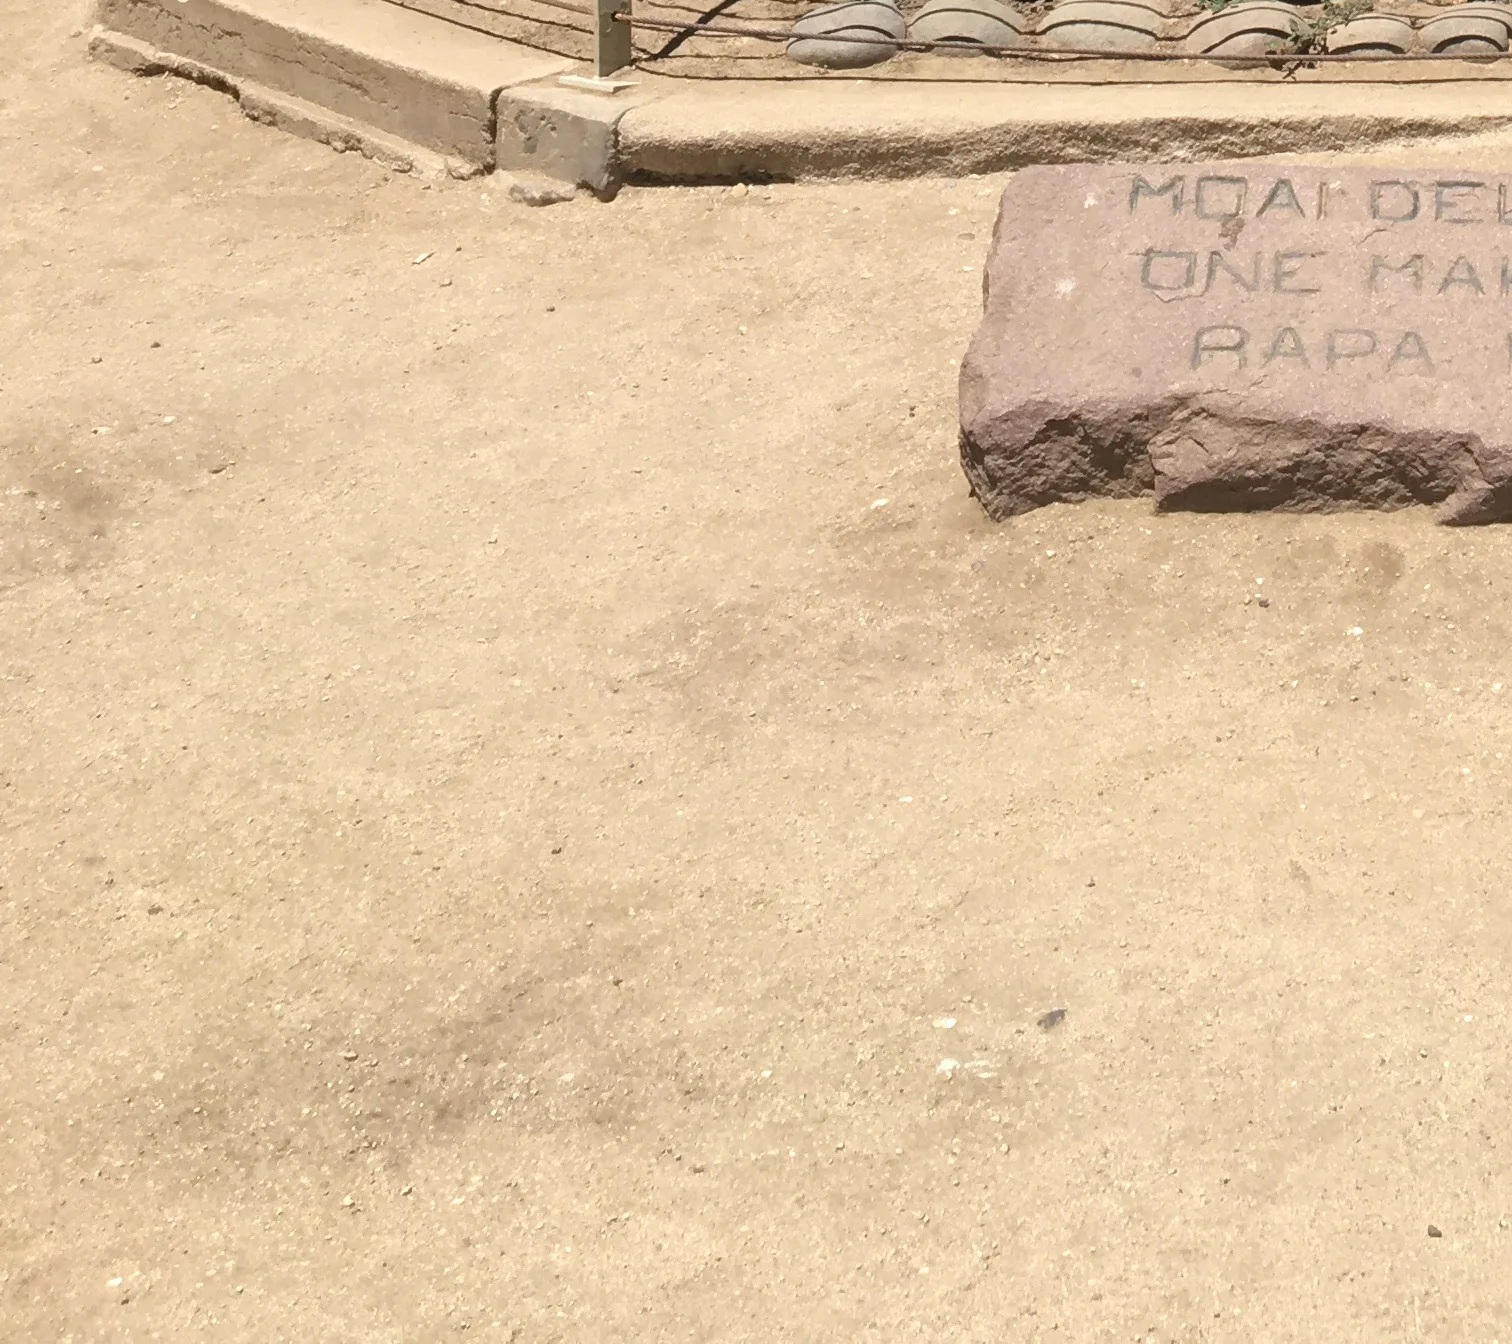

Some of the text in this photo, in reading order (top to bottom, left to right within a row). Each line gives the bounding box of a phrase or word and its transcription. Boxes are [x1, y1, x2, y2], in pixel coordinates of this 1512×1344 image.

[1129, 174, 1331, 220] MOAI
[1138, 249, 1326, 294] ONE
[1190, 324, 1435, 373] RAPA
